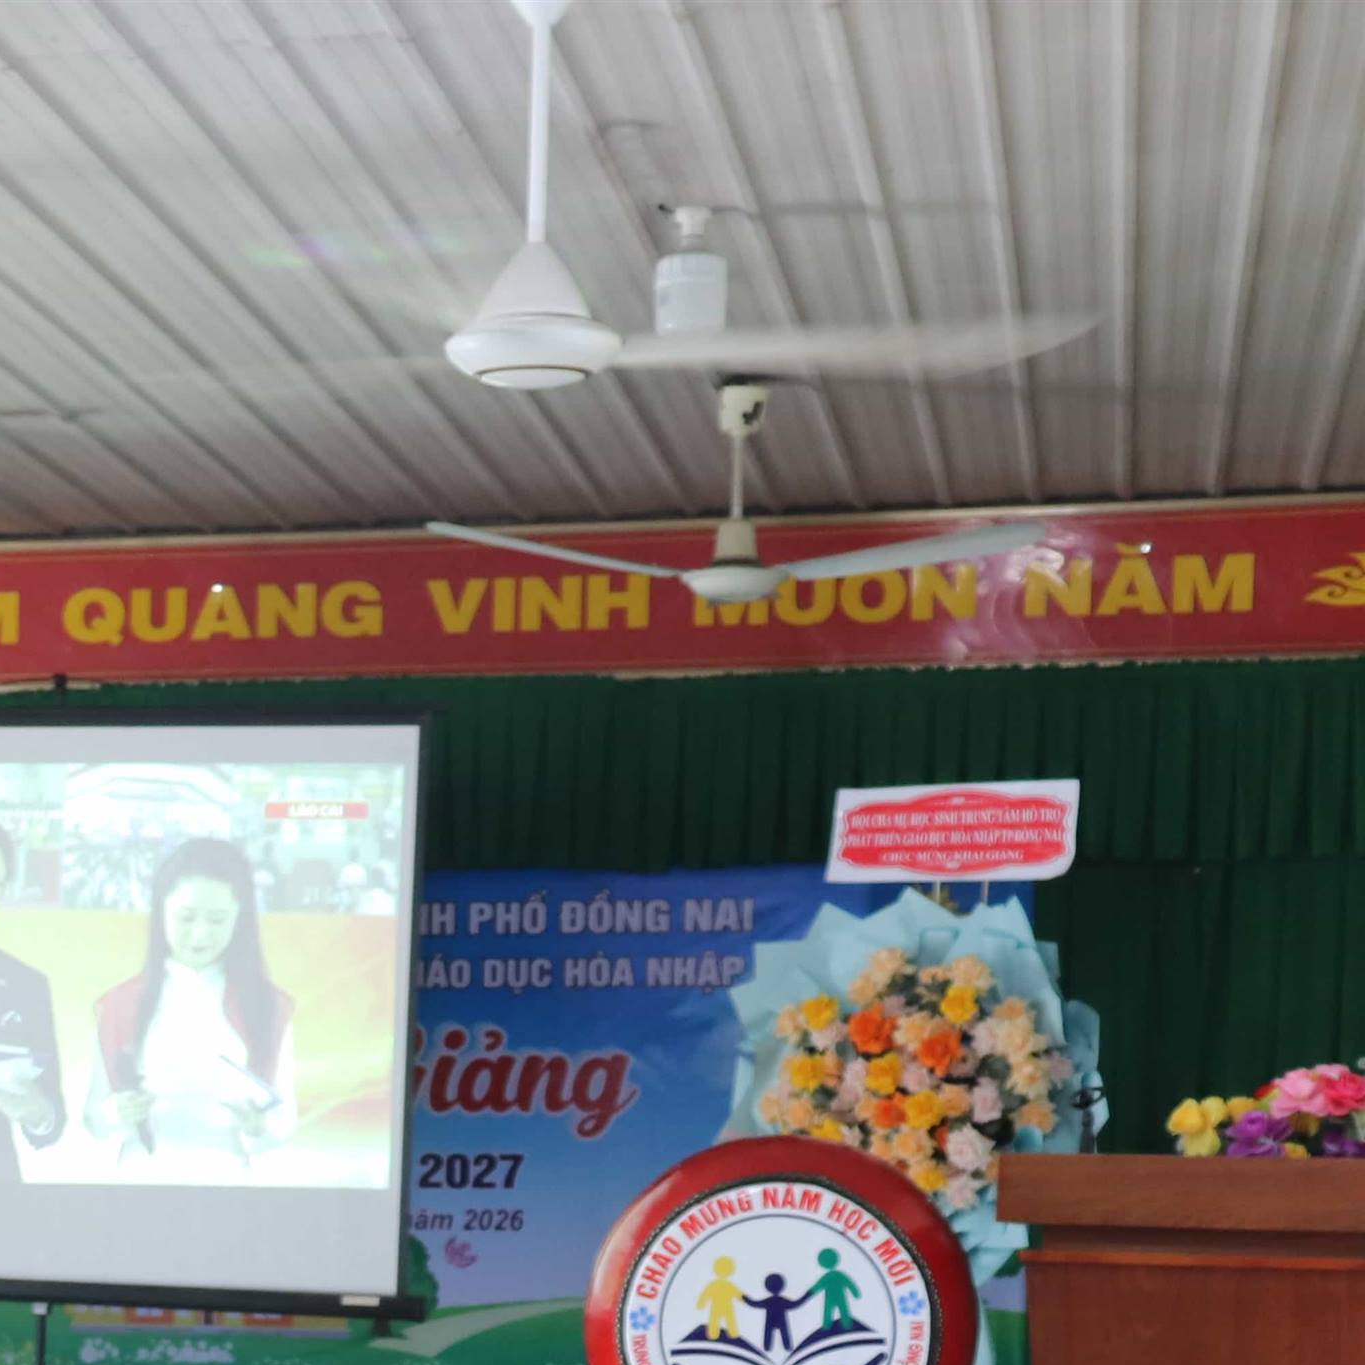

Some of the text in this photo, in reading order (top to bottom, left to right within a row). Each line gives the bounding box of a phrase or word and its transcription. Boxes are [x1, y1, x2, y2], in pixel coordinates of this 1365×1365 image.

[62, 579, 384, 648] QUANG
[428, 574, 650, 633] VINH
[1023, 542, 1256, 618] NĂM
[469, 889, 548, 935] PHỐ
[561, 888, 671, 933] ĐỒNG
[684, 897, 755, 932] NAI
[416, 950, 746, 994] IÁO DỤC HÒA NHẬP
[412, 1028, 639, 1138] iảng
[418, 1152, 525, 1189] 2027
[463, 1207, 525, 1232] 2026
[827, 1198, 879, 1242] HỌC
[873, 1237, 917, 1288] MỚI
